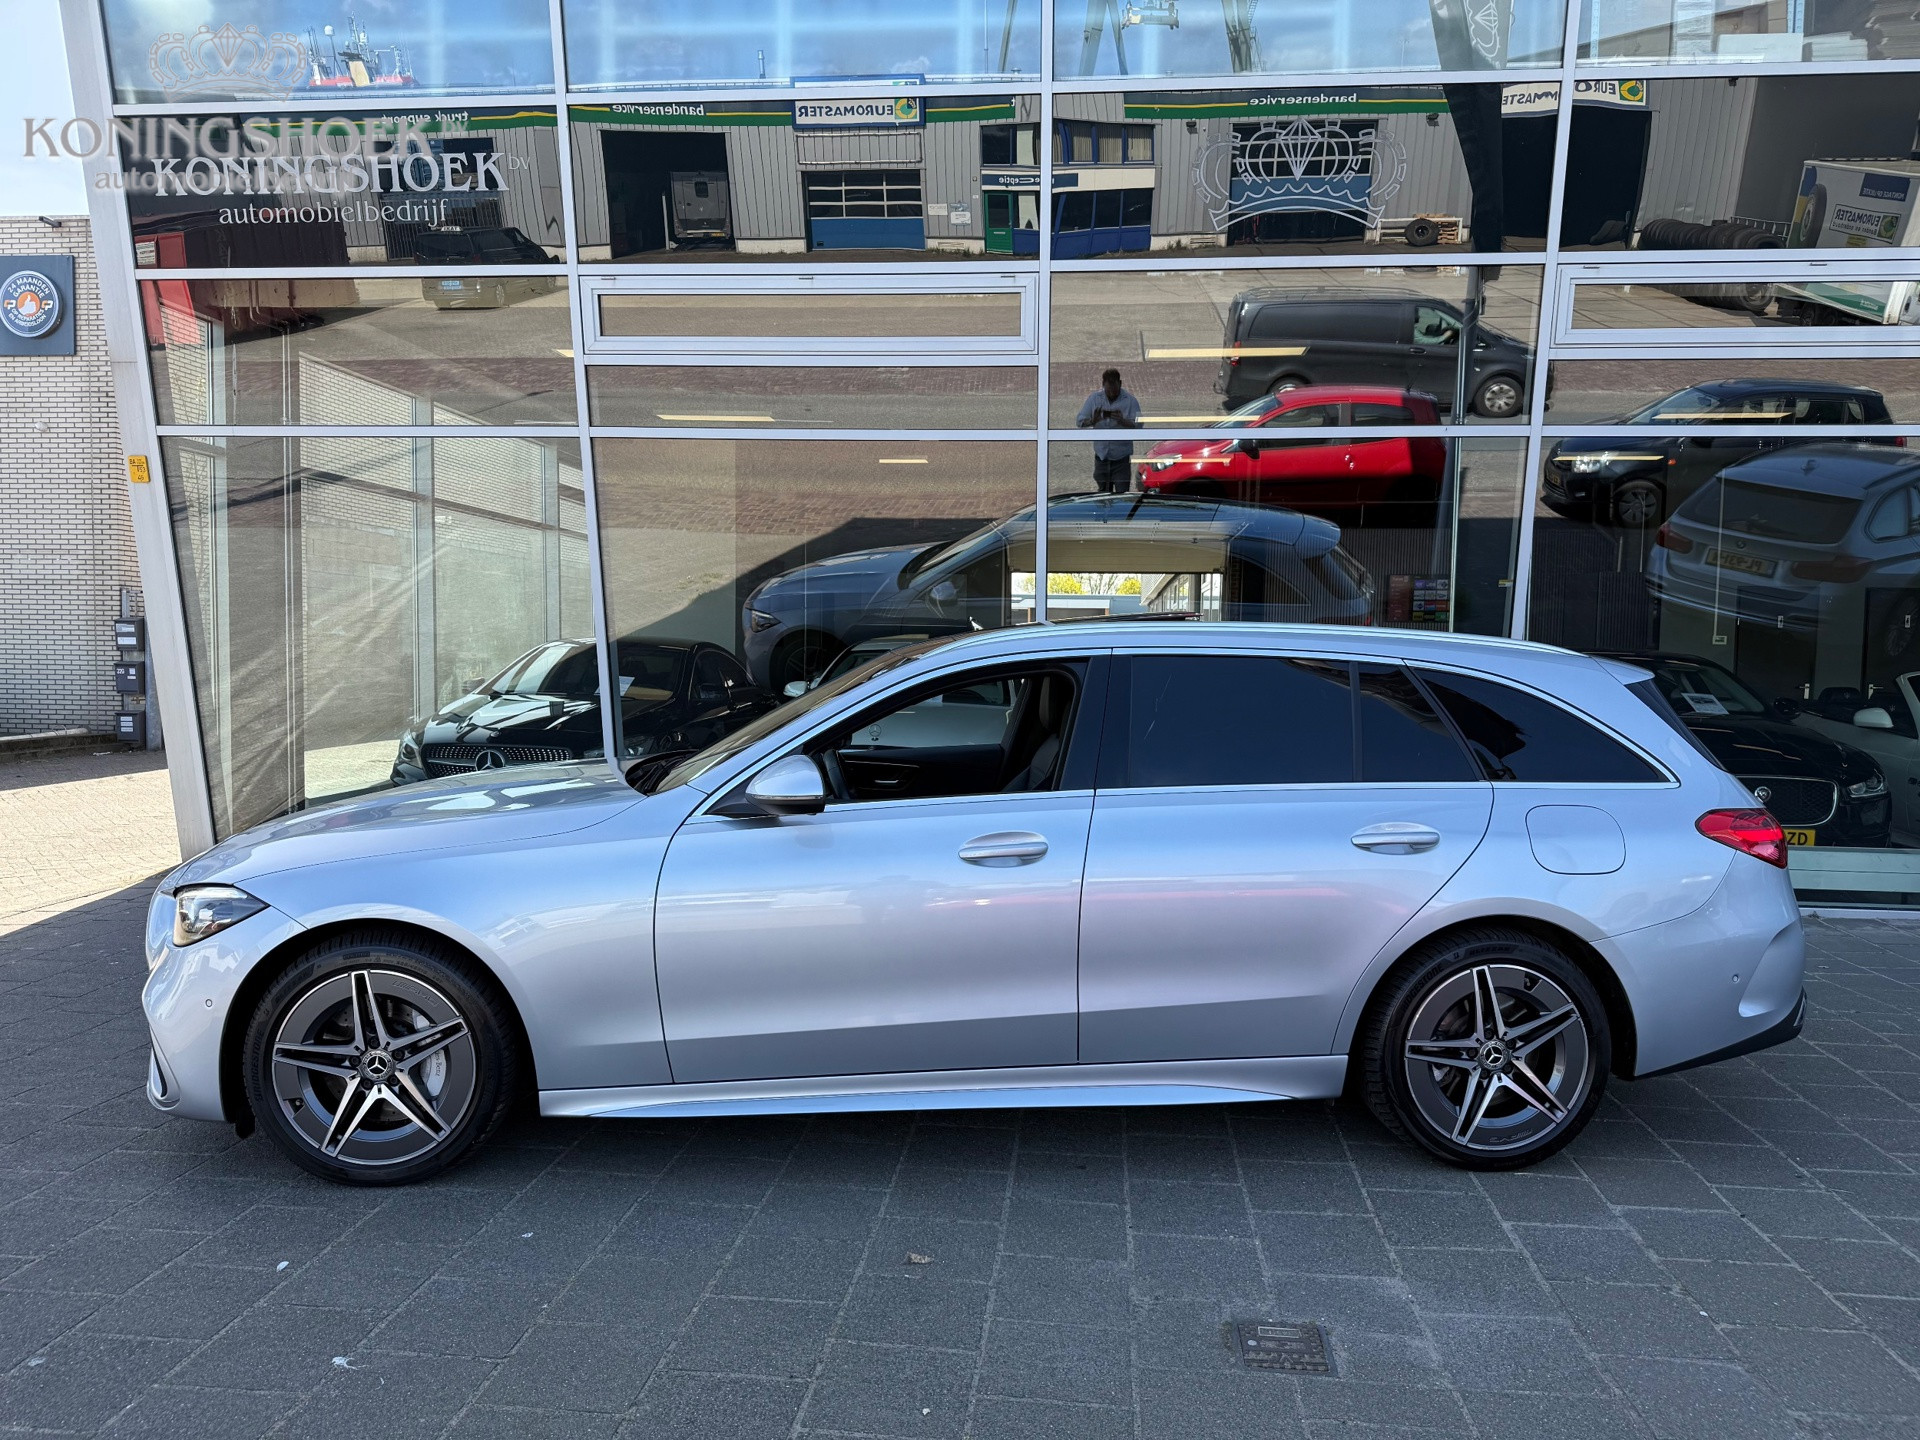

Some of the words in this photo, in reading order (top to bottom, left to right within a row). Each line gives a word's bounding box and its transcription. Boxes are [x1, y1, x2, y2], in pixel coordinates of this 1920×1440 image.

[150, 152, 510, 197] KONINGSHOEK
[509, 153, 531, 170] bv
[219, 198, 449, 227] automobielbedrijf
[8, 283, 17, 293] 24
[16, 277, 51, 294] MAANDEN
[12, 284, 46, 298] GARANTIE
[253, 1028, 265, 1102] BRIDGESTONE
